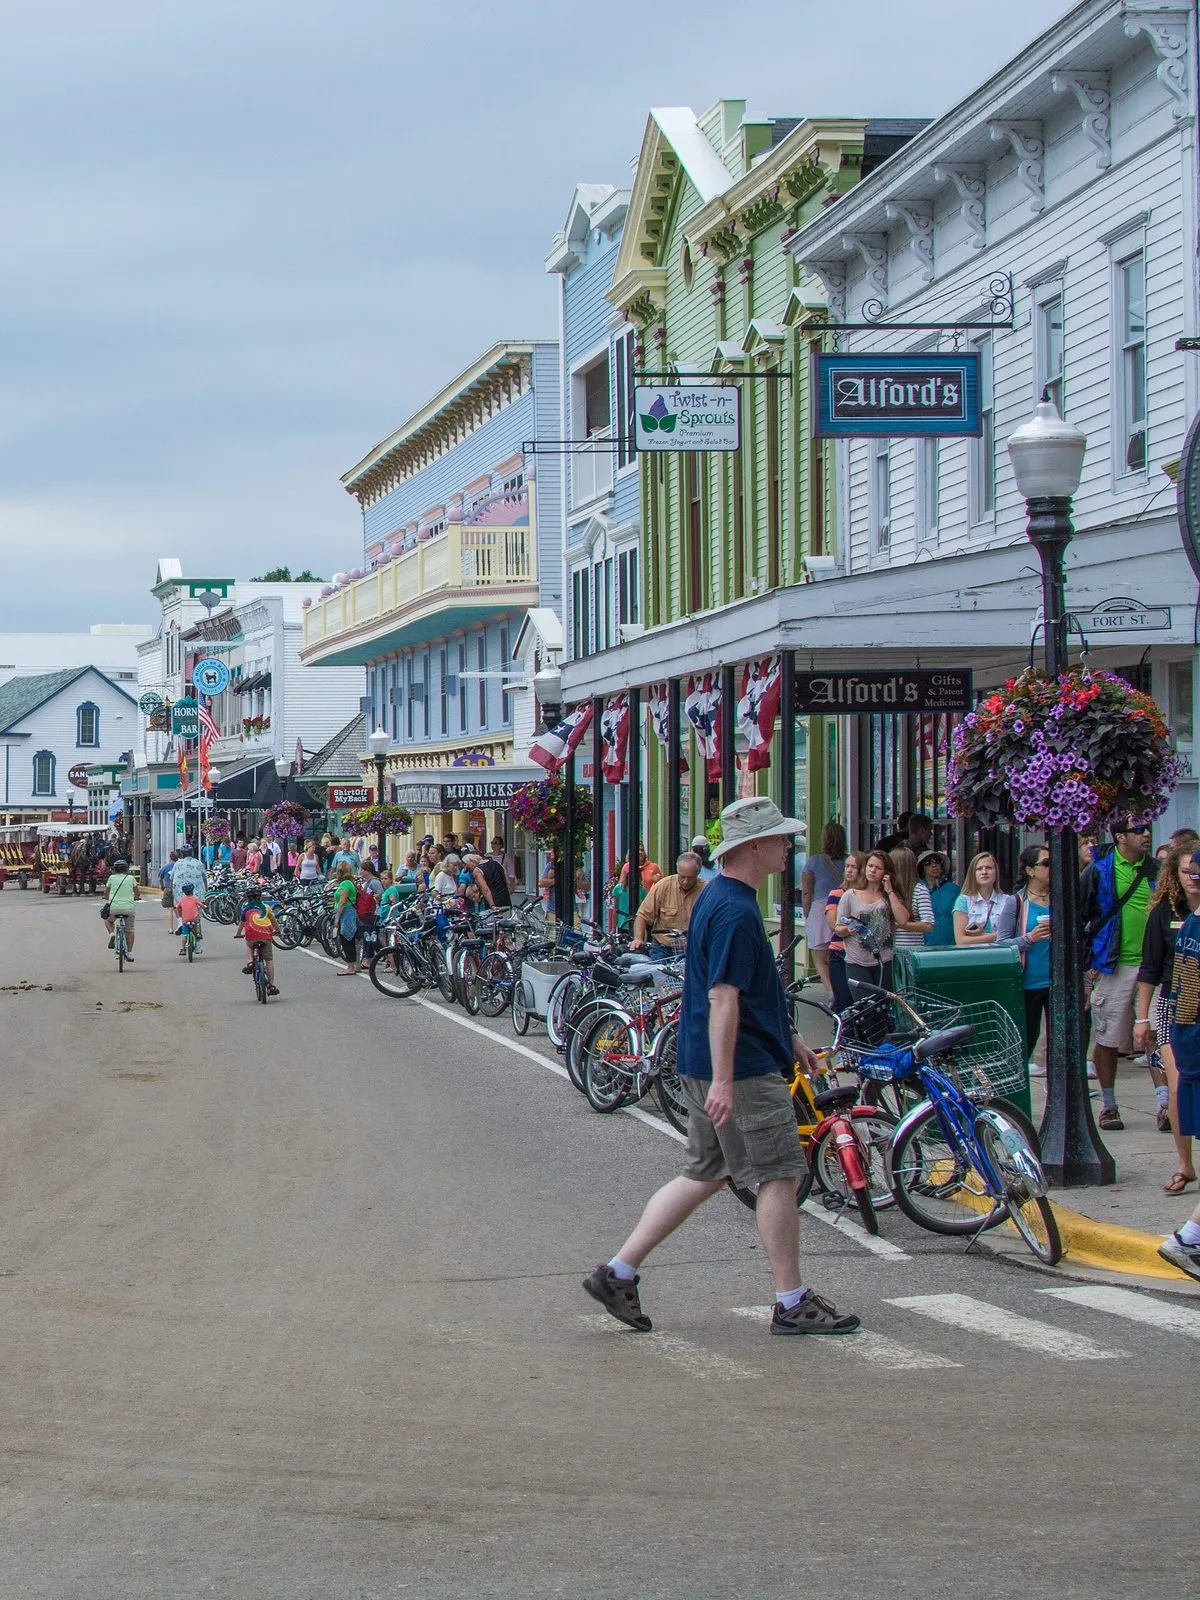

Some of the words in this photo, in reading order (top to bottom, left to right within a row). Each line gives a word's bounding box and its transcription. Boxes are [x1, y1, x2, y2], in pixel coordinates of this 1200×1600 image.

[836, 377, 959, 408] Alford's
[669, 390, 708, 408] Twist
[679, 429, 714, 437] Premium
[1092, 615, 1125, 627] FORT
[1130, 614, 1150, 625] ST.
[931, 675, 962, 686] Gifts
[808, 676, 918, 705] Alford's
[927, 688, 937, 696] &
[938, 687, 964, 696] Patent
[924, 698, 966, 708] Medicines
[180, 724, 198, 734] BAR
[458, 800, 473, 808] THE
